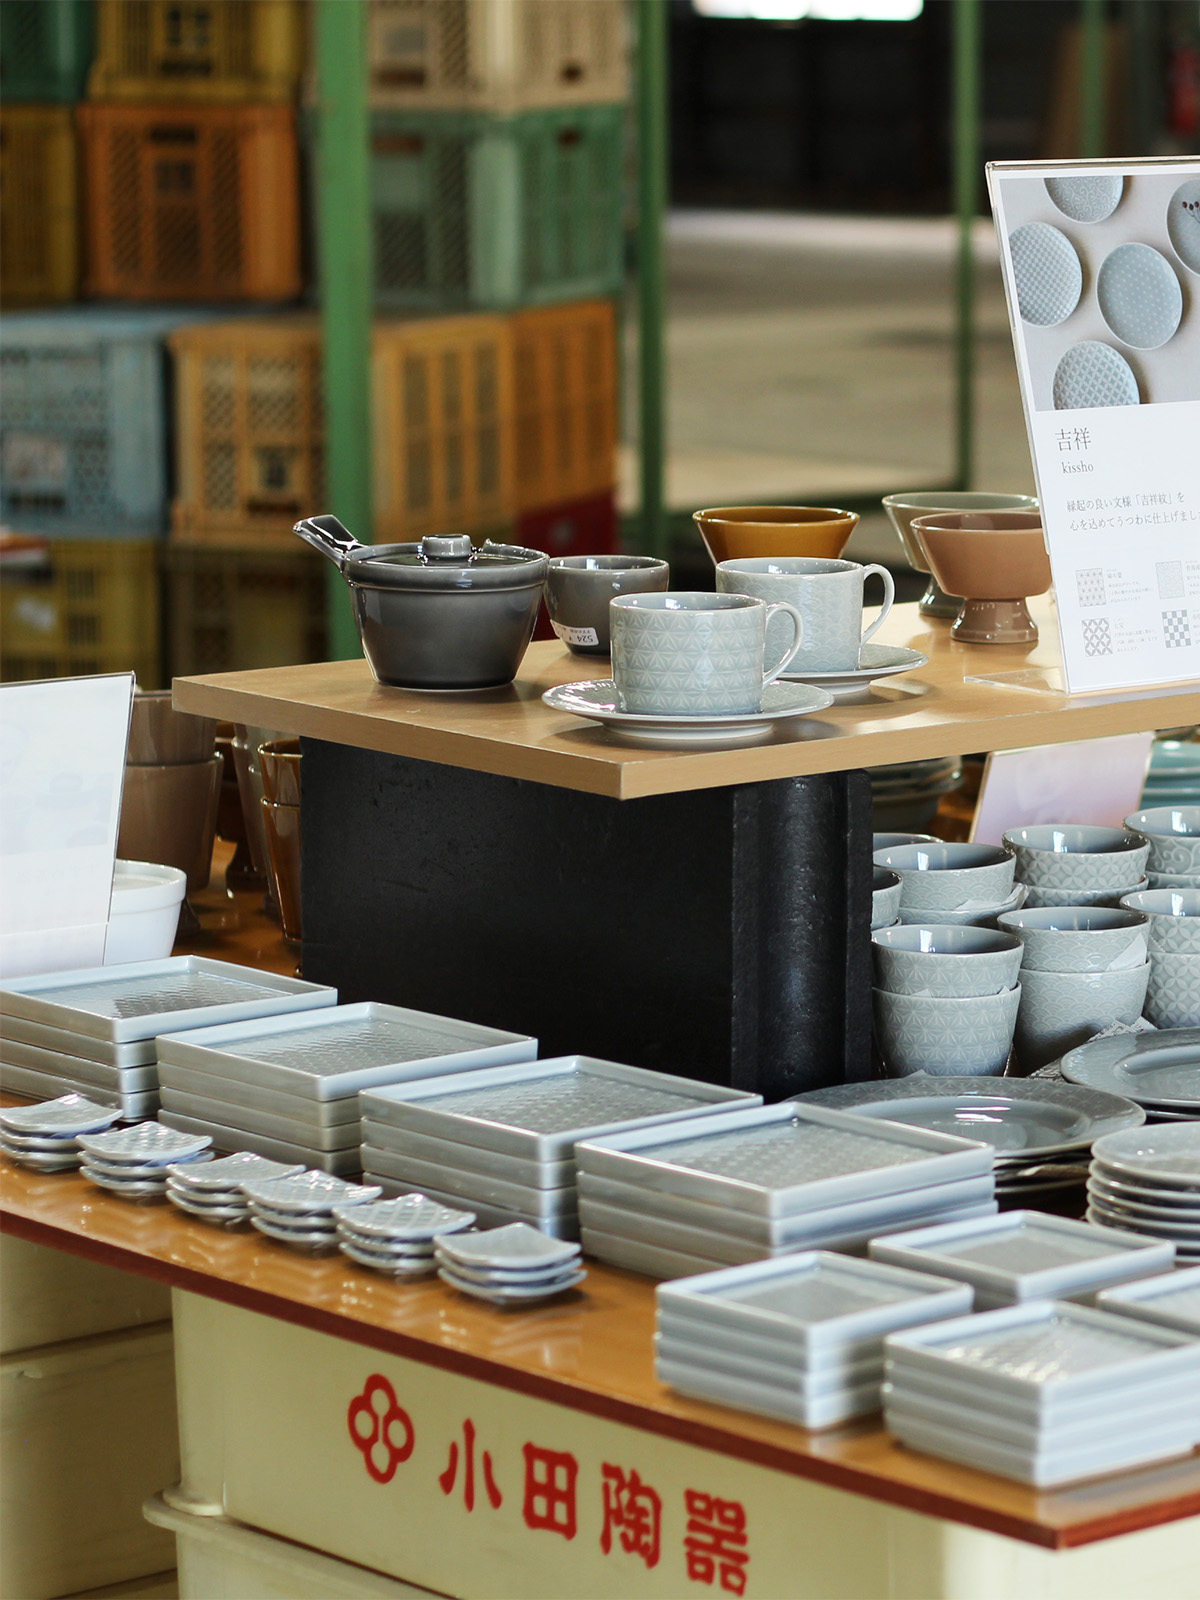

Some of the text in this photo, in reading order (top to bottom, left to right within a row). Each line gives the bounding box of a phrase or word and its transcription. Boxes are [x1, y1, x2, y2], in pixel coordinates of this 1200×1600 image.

[1054, 427, 1091, 451] 吉祥
[1061, 460, 1094, 474] kissho
[438, 1418, 750, 1597] 小田陶器
